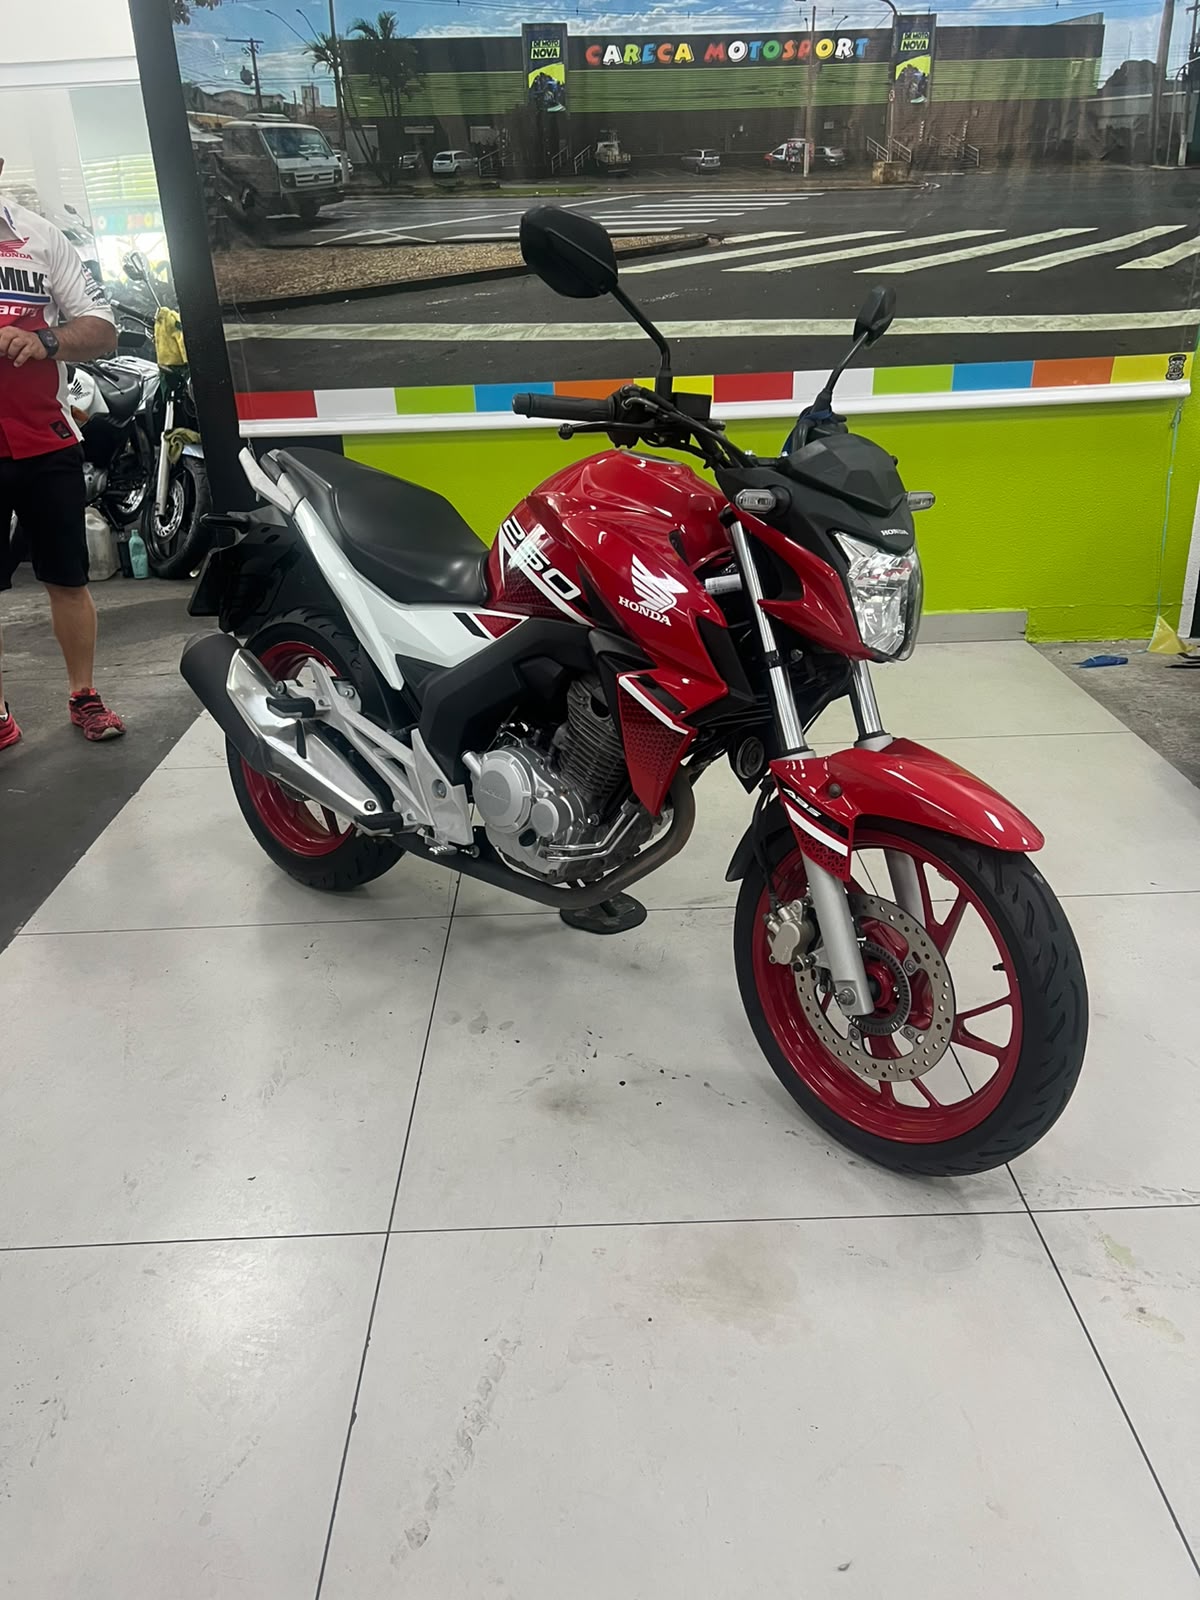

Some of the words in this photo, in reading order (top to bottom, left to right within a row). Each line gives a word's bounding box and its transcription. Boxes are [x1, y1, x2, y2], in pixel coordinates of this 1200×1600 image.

[533, 49, 558, 58] NOVA
[585, 42, 694, 65] CARECA
[704, 37, 869, 62] MOTOSPORT
[903, 41, 927, 50] NOVA
[0, 266, 46, 295] MILK
[880, 528, 909, 536] HONDA
[502, 515, 582, 600] 250
[618, 594, 673, 627] HONDA
[782, 787, 822, 818] ABS
